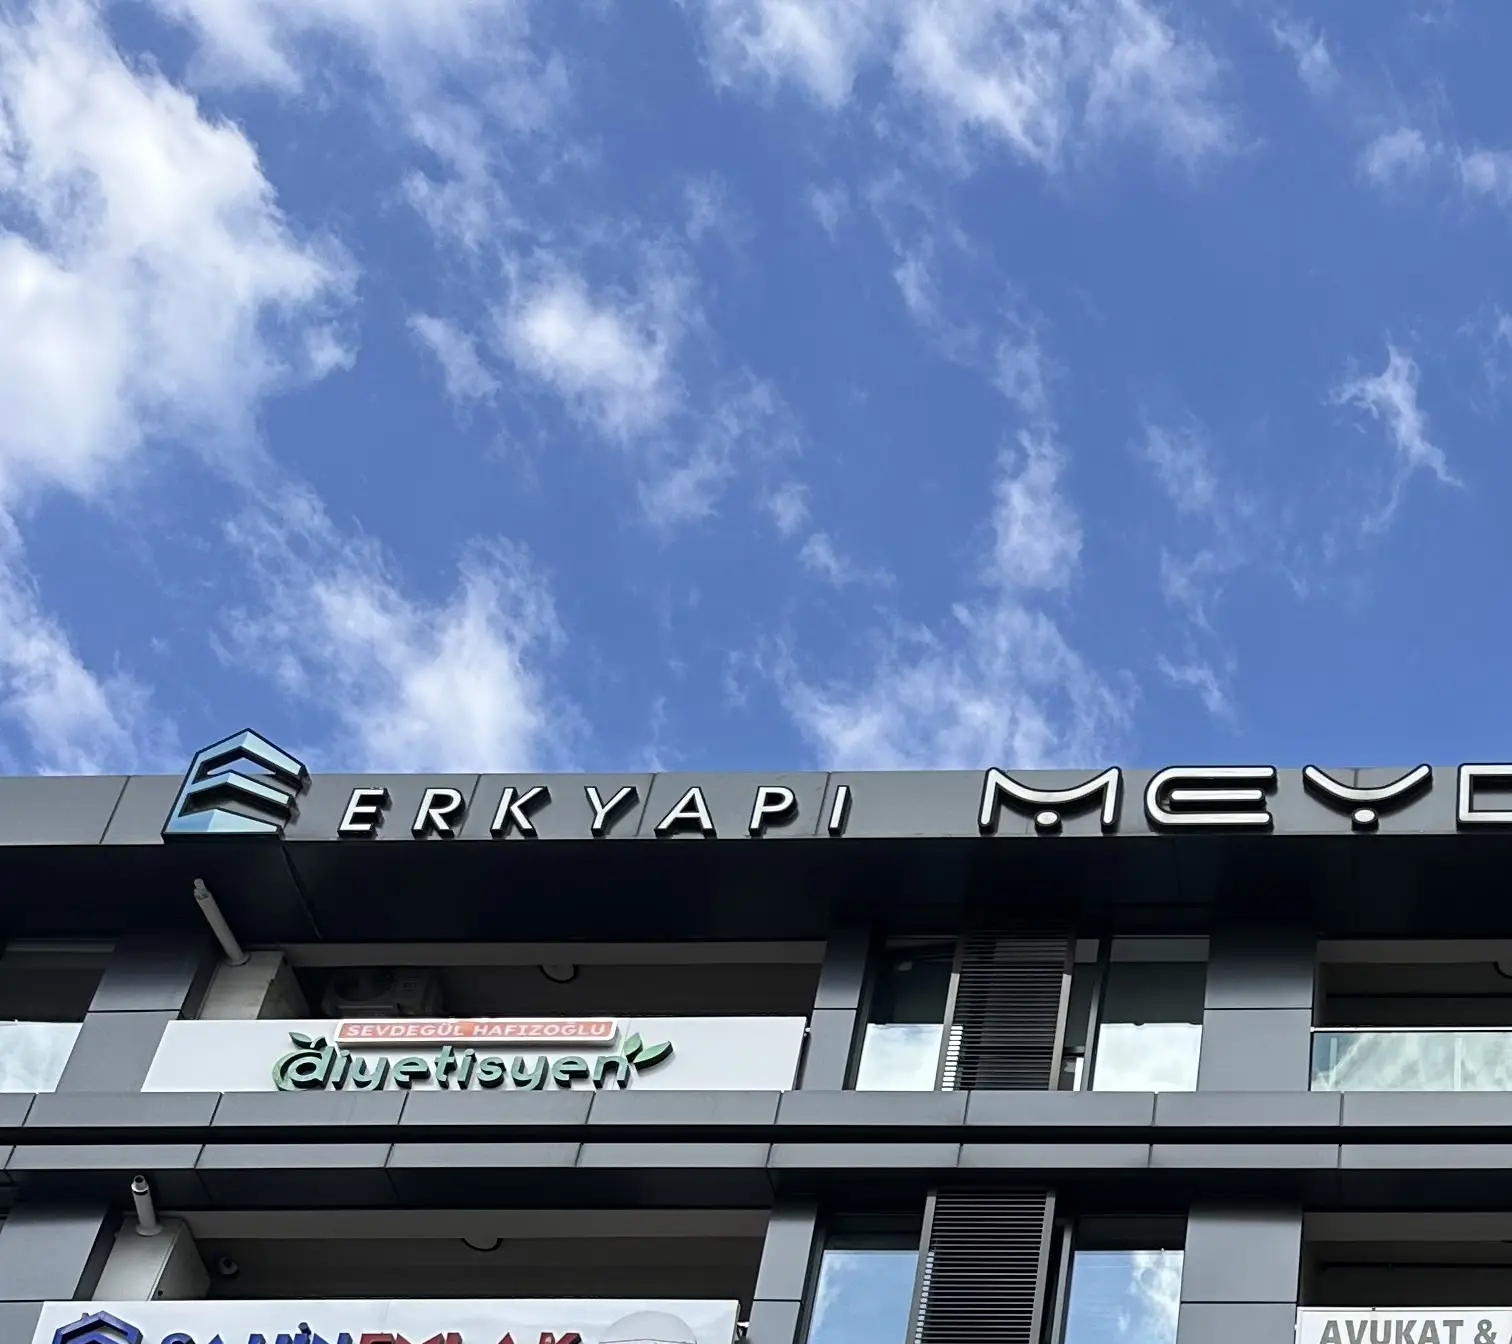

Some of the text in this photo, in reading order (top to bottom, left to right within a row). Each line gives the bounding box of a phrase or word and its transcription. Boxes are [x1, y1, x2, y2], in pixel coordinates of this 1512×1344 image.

[337, 785, 852, 838] ERKYAPI
[346, 1018, 606, 1037] SEVDEGÜL HAFIZOĞLU
[281, 1044, 634, 1091] diyetisyen
